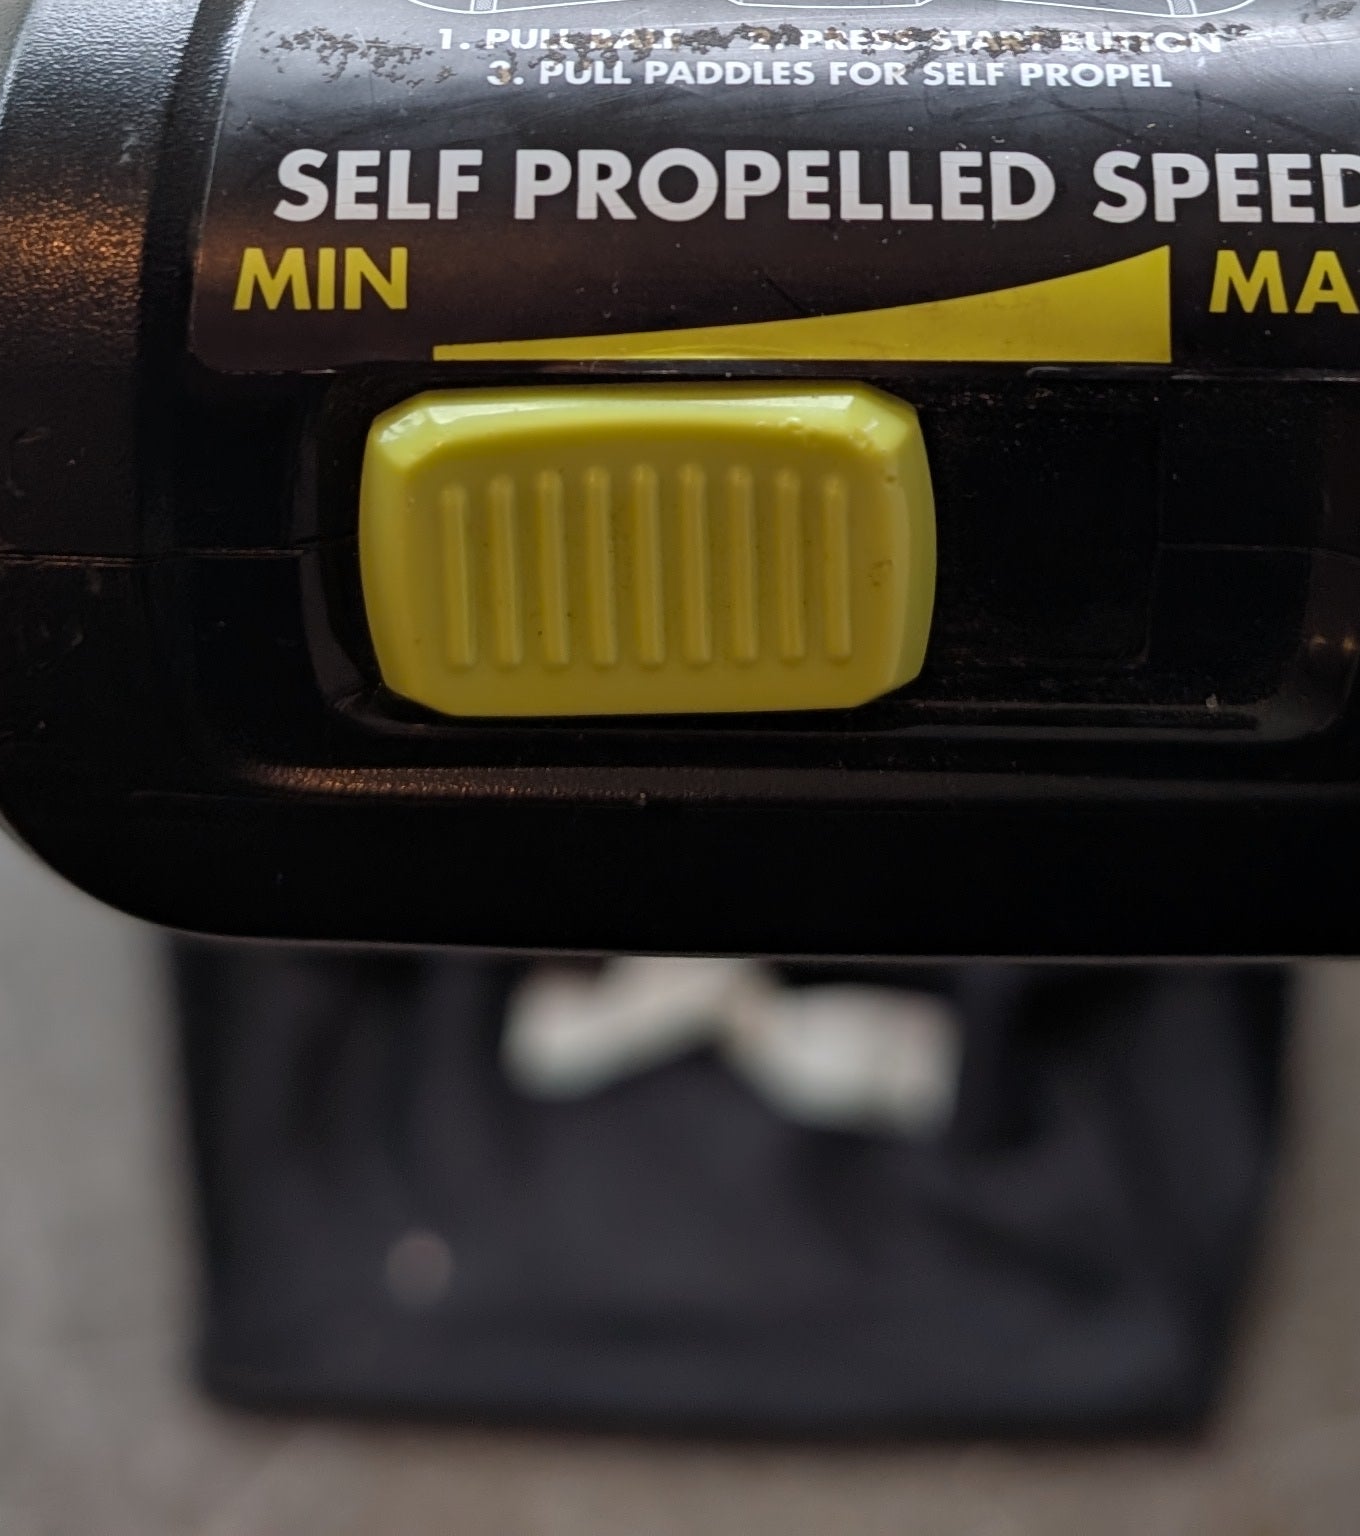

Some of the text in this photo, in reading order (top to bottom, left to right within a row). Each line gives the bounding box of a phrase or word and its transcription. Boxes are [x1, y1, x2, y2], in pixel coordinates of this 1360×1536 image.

[439, 29, 470, 49] 1.
[485, 29, 575, 49] PULL
[800, 30, 917, 51] PRESS
[931, 30, 1045, 51] START
[1061, 31, 1222, 52] BUTTON
[487, 60, 1173, 87] 3. PULL PADDLES FOR SELF PROPEL
[273, 148, 484, 222] SELF
[515, 148, 1057, 224] PROPELLED
[233, 246, 409, 311] MIN
